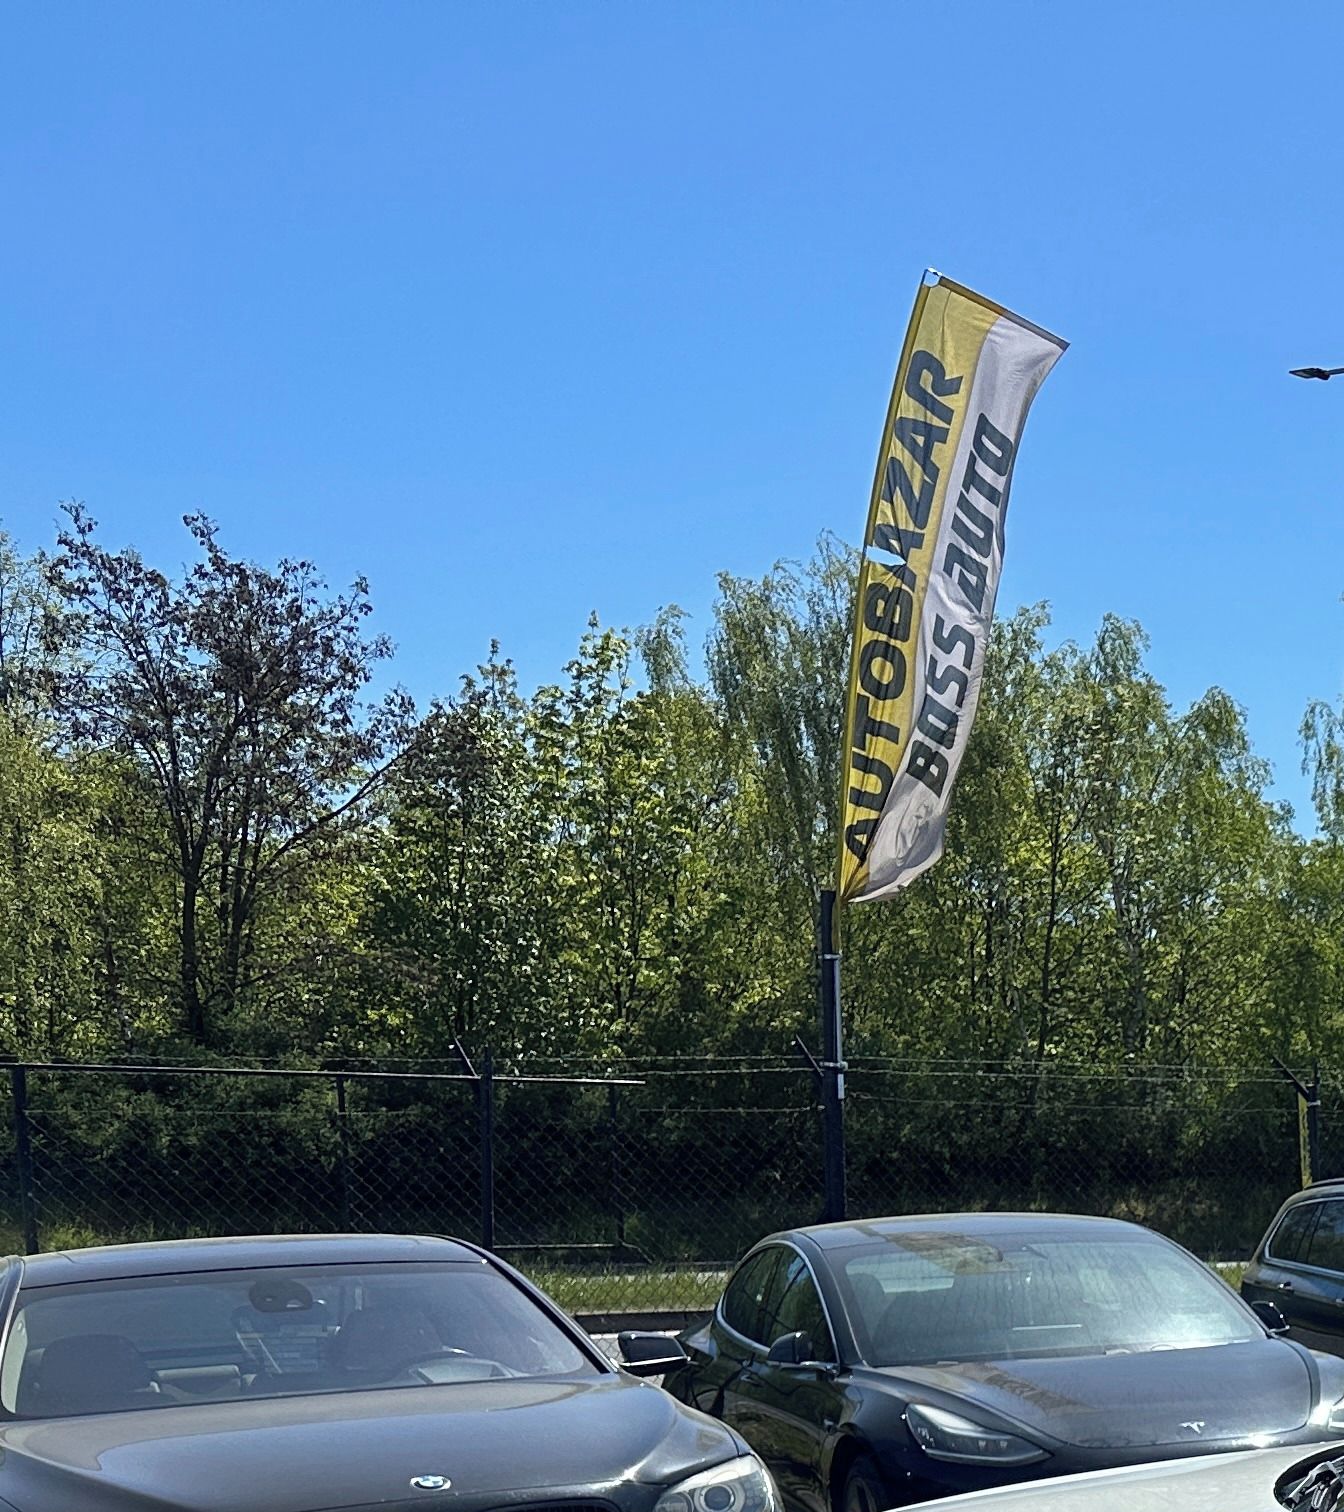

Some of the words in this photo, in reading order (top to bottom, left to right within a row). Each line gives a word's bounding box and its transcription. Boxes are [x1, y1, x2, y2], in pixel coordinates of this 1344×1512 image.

[844, 347, 963, 867] AUTOBAZAR
[905, 612, 976, 799] BOSS
[943, 412, 1014, 613] AUTO
